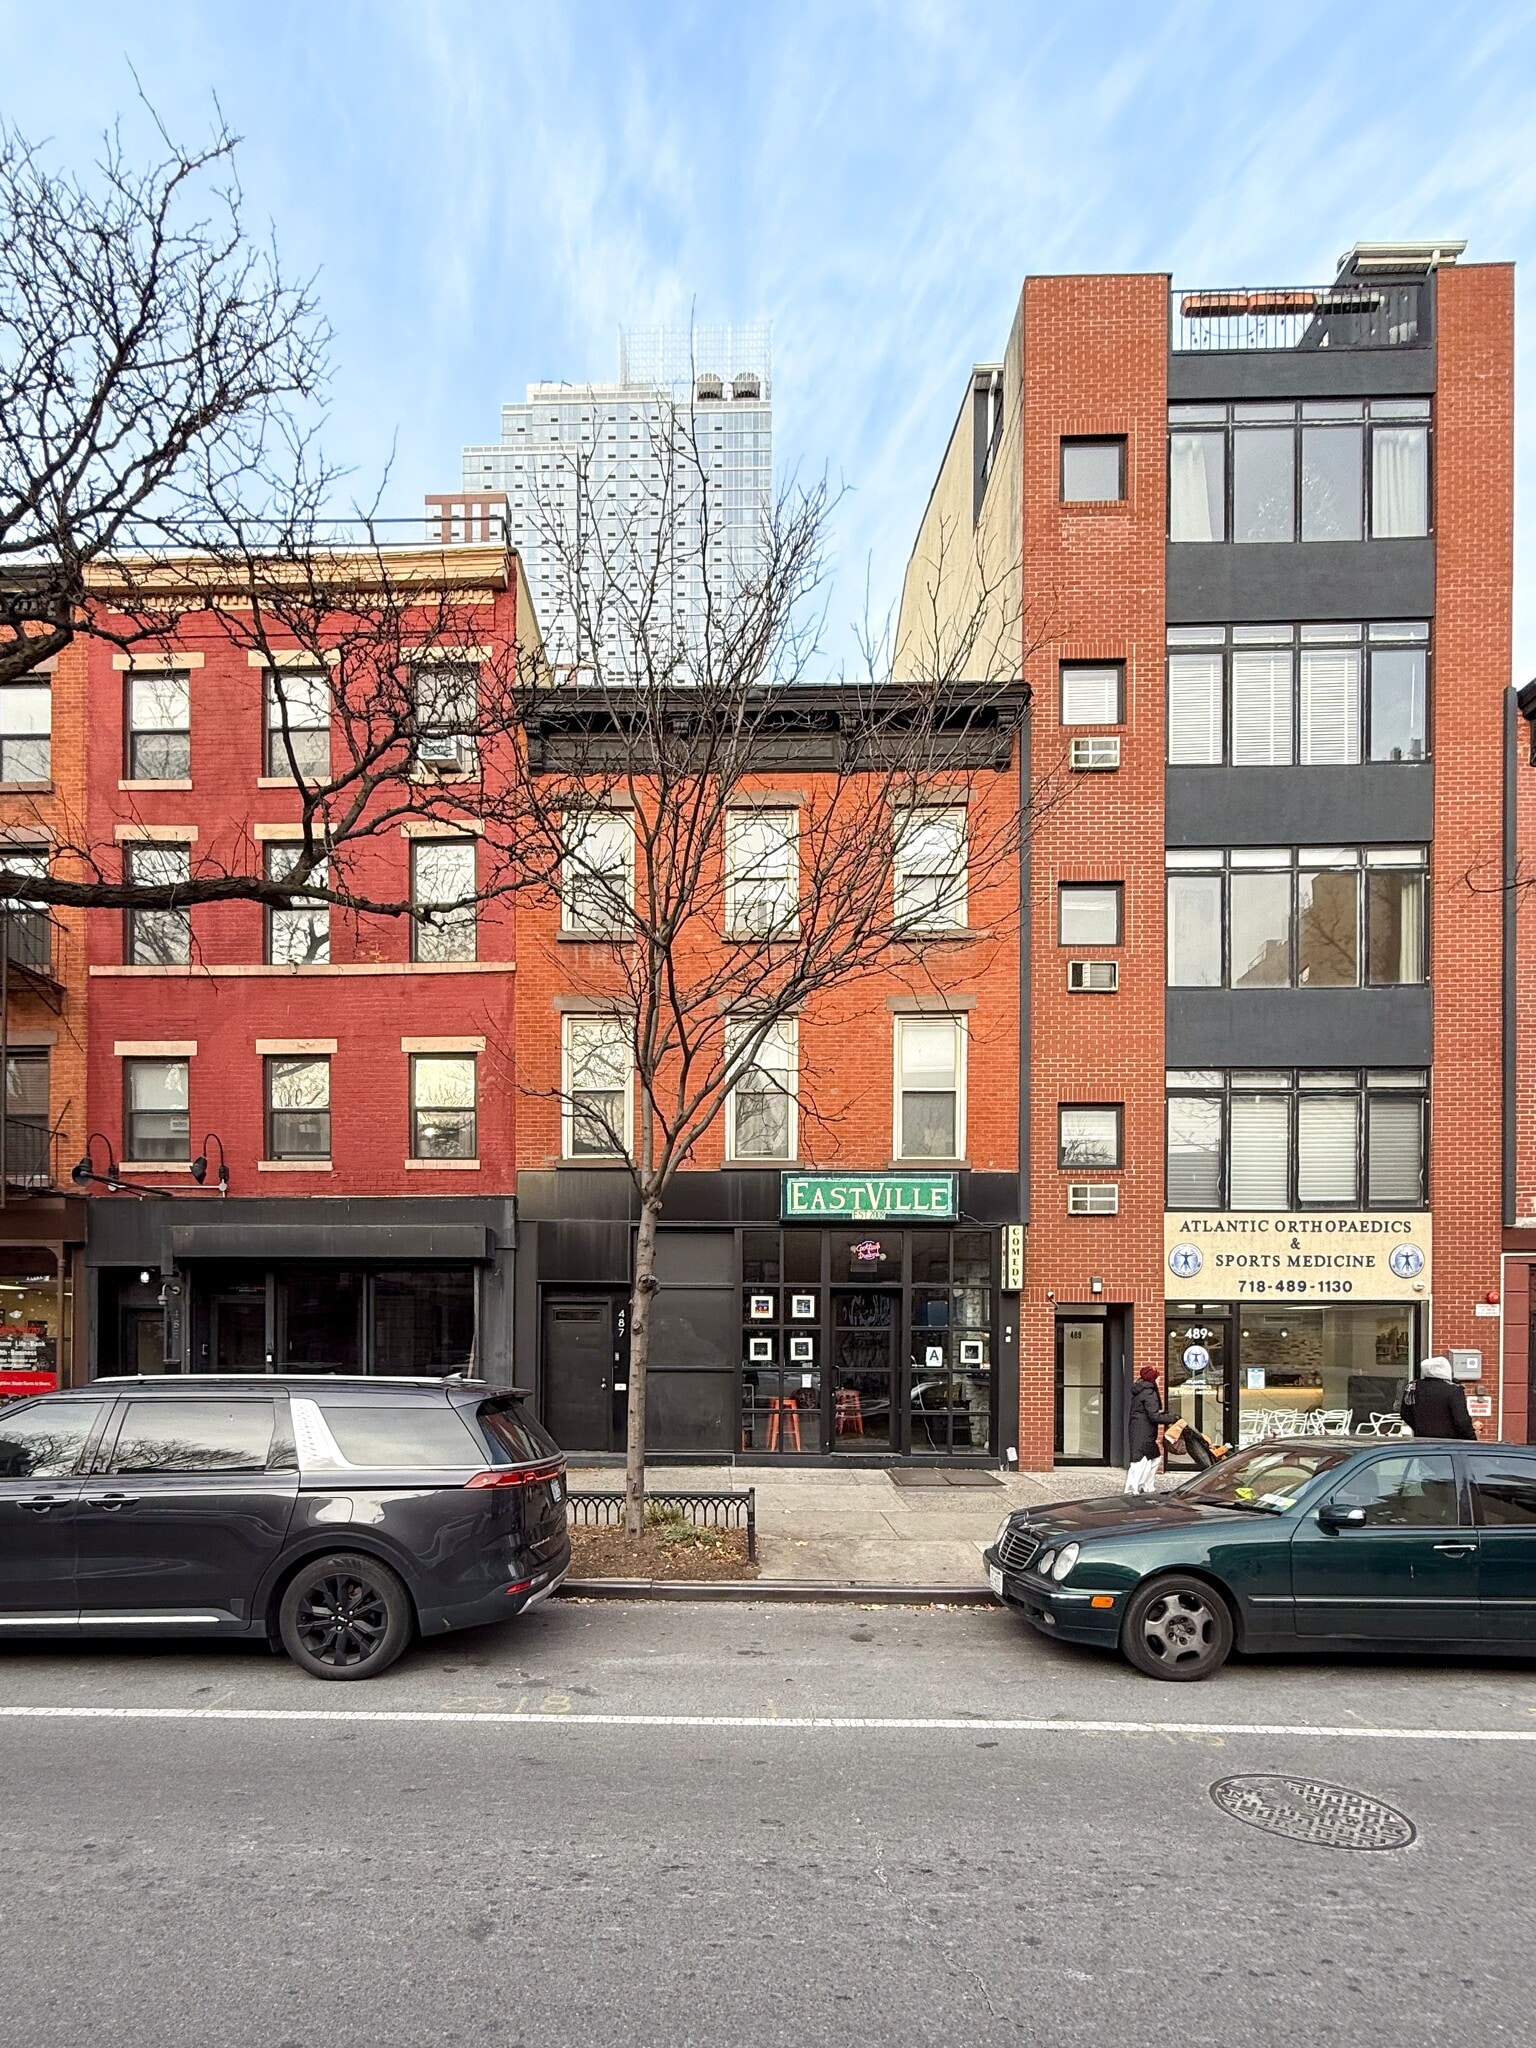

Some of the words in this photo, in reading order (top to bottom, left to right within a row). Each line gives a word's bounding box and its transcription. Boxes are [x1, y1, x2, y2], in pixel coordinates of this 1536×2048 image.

[853, 1210, 867, 1219] EST
[869, 1210, 886, 1219] 2008
[1179, 1220, 1270, 1233] ATLANTIC
[1274, 1220, 1412, 1233] ORTHOPAEDICS
[1290, 1237, 1301, 1250] &
[1011, 1227, 1020, 1286] COMEDY
[1215, 1254, 1281, 1268] SPORTS
[1287, 1254, 1376, 1268] MEDICINE
[1238, 1280, 1353, 1293] 718-489-1130
[1184, 1327, 1208, 1339] 489
[929, 1349, 939, 1361] A
